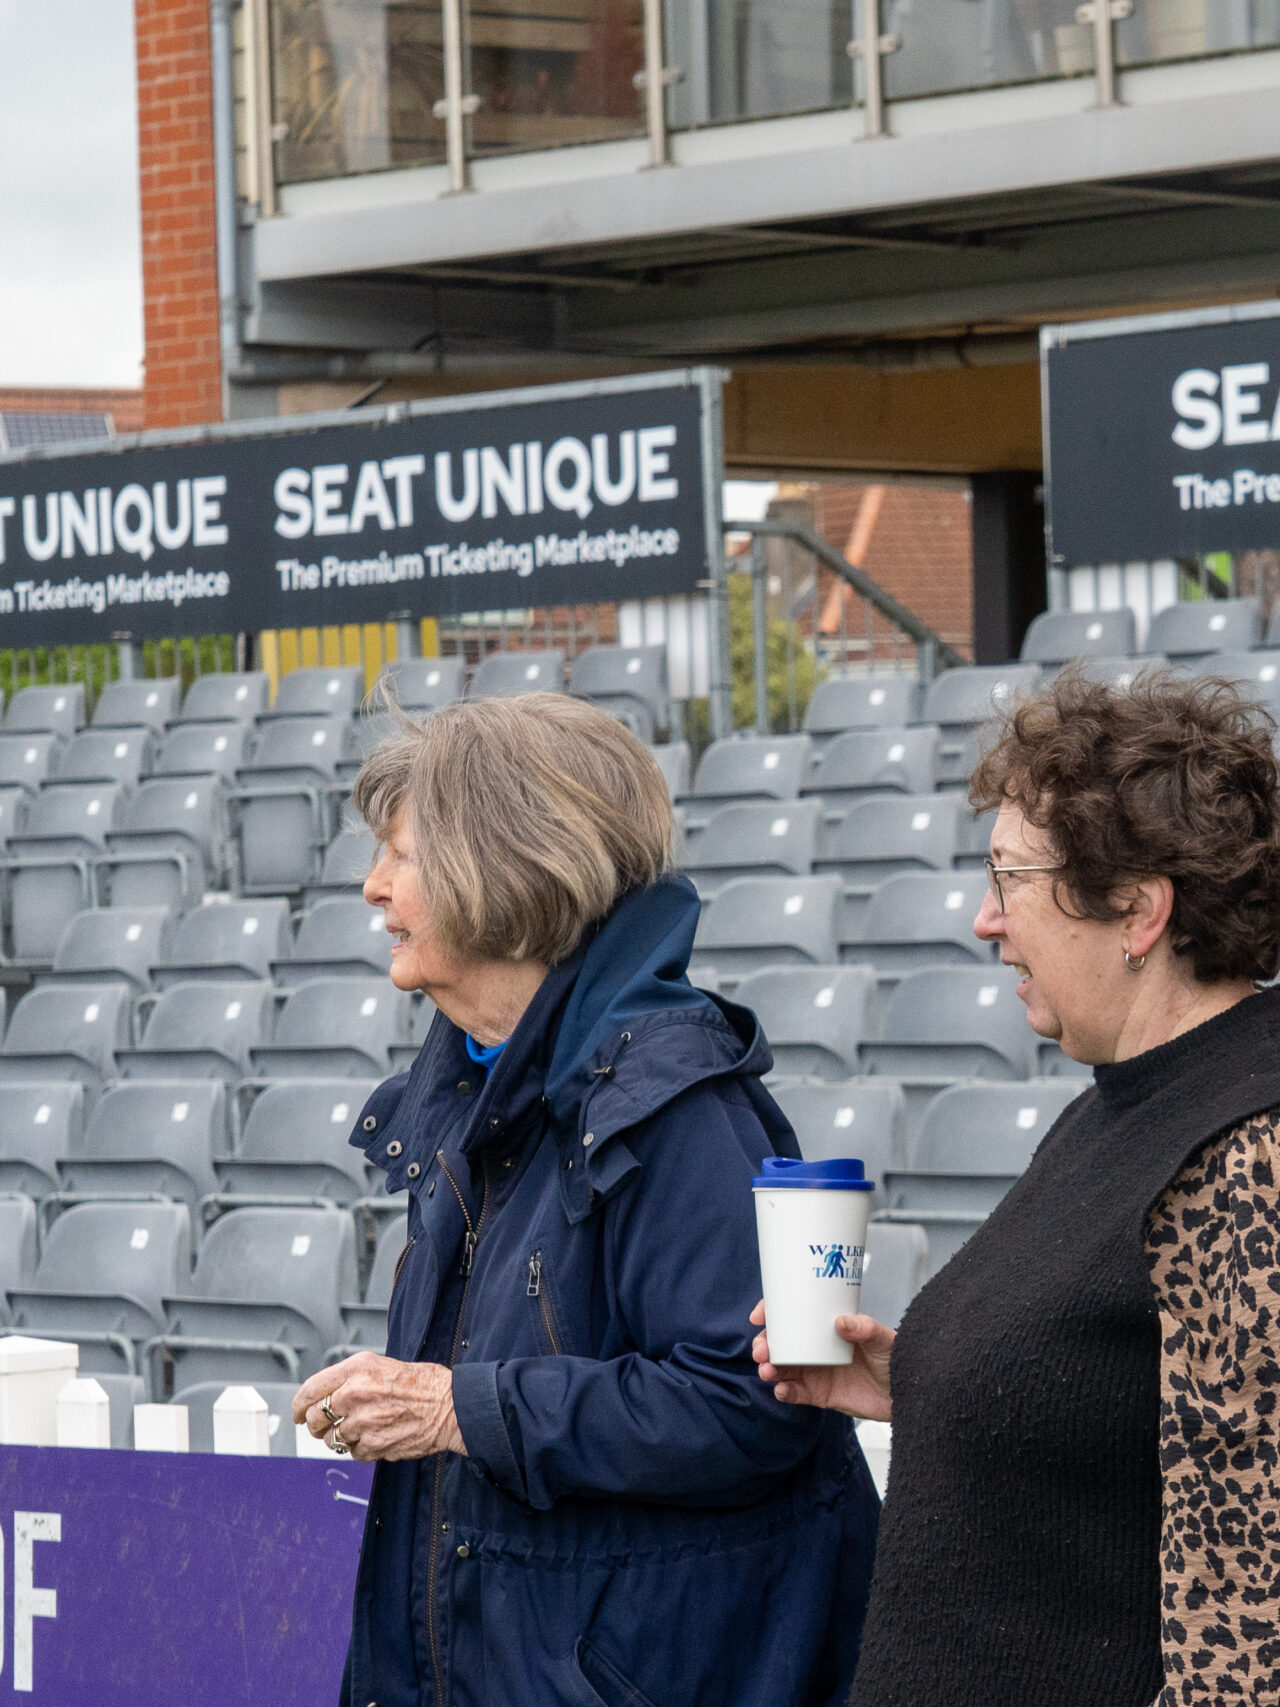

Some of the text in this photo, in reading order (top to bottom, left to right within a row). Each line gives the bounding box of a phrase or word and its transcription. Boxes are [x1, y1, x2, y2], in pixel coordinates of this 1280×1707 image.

[273, 426, 679, 539] SEAT UNIQUE
[1173, 474, 1231, 511] The
[22, 475, 230, 561] UNIQUE
[14, 576, 106, 614] Ticketing
[106, 567, 230, 607] Marketplace
[276, 525, 680, 591] The Premium Ticketing Marketplace
